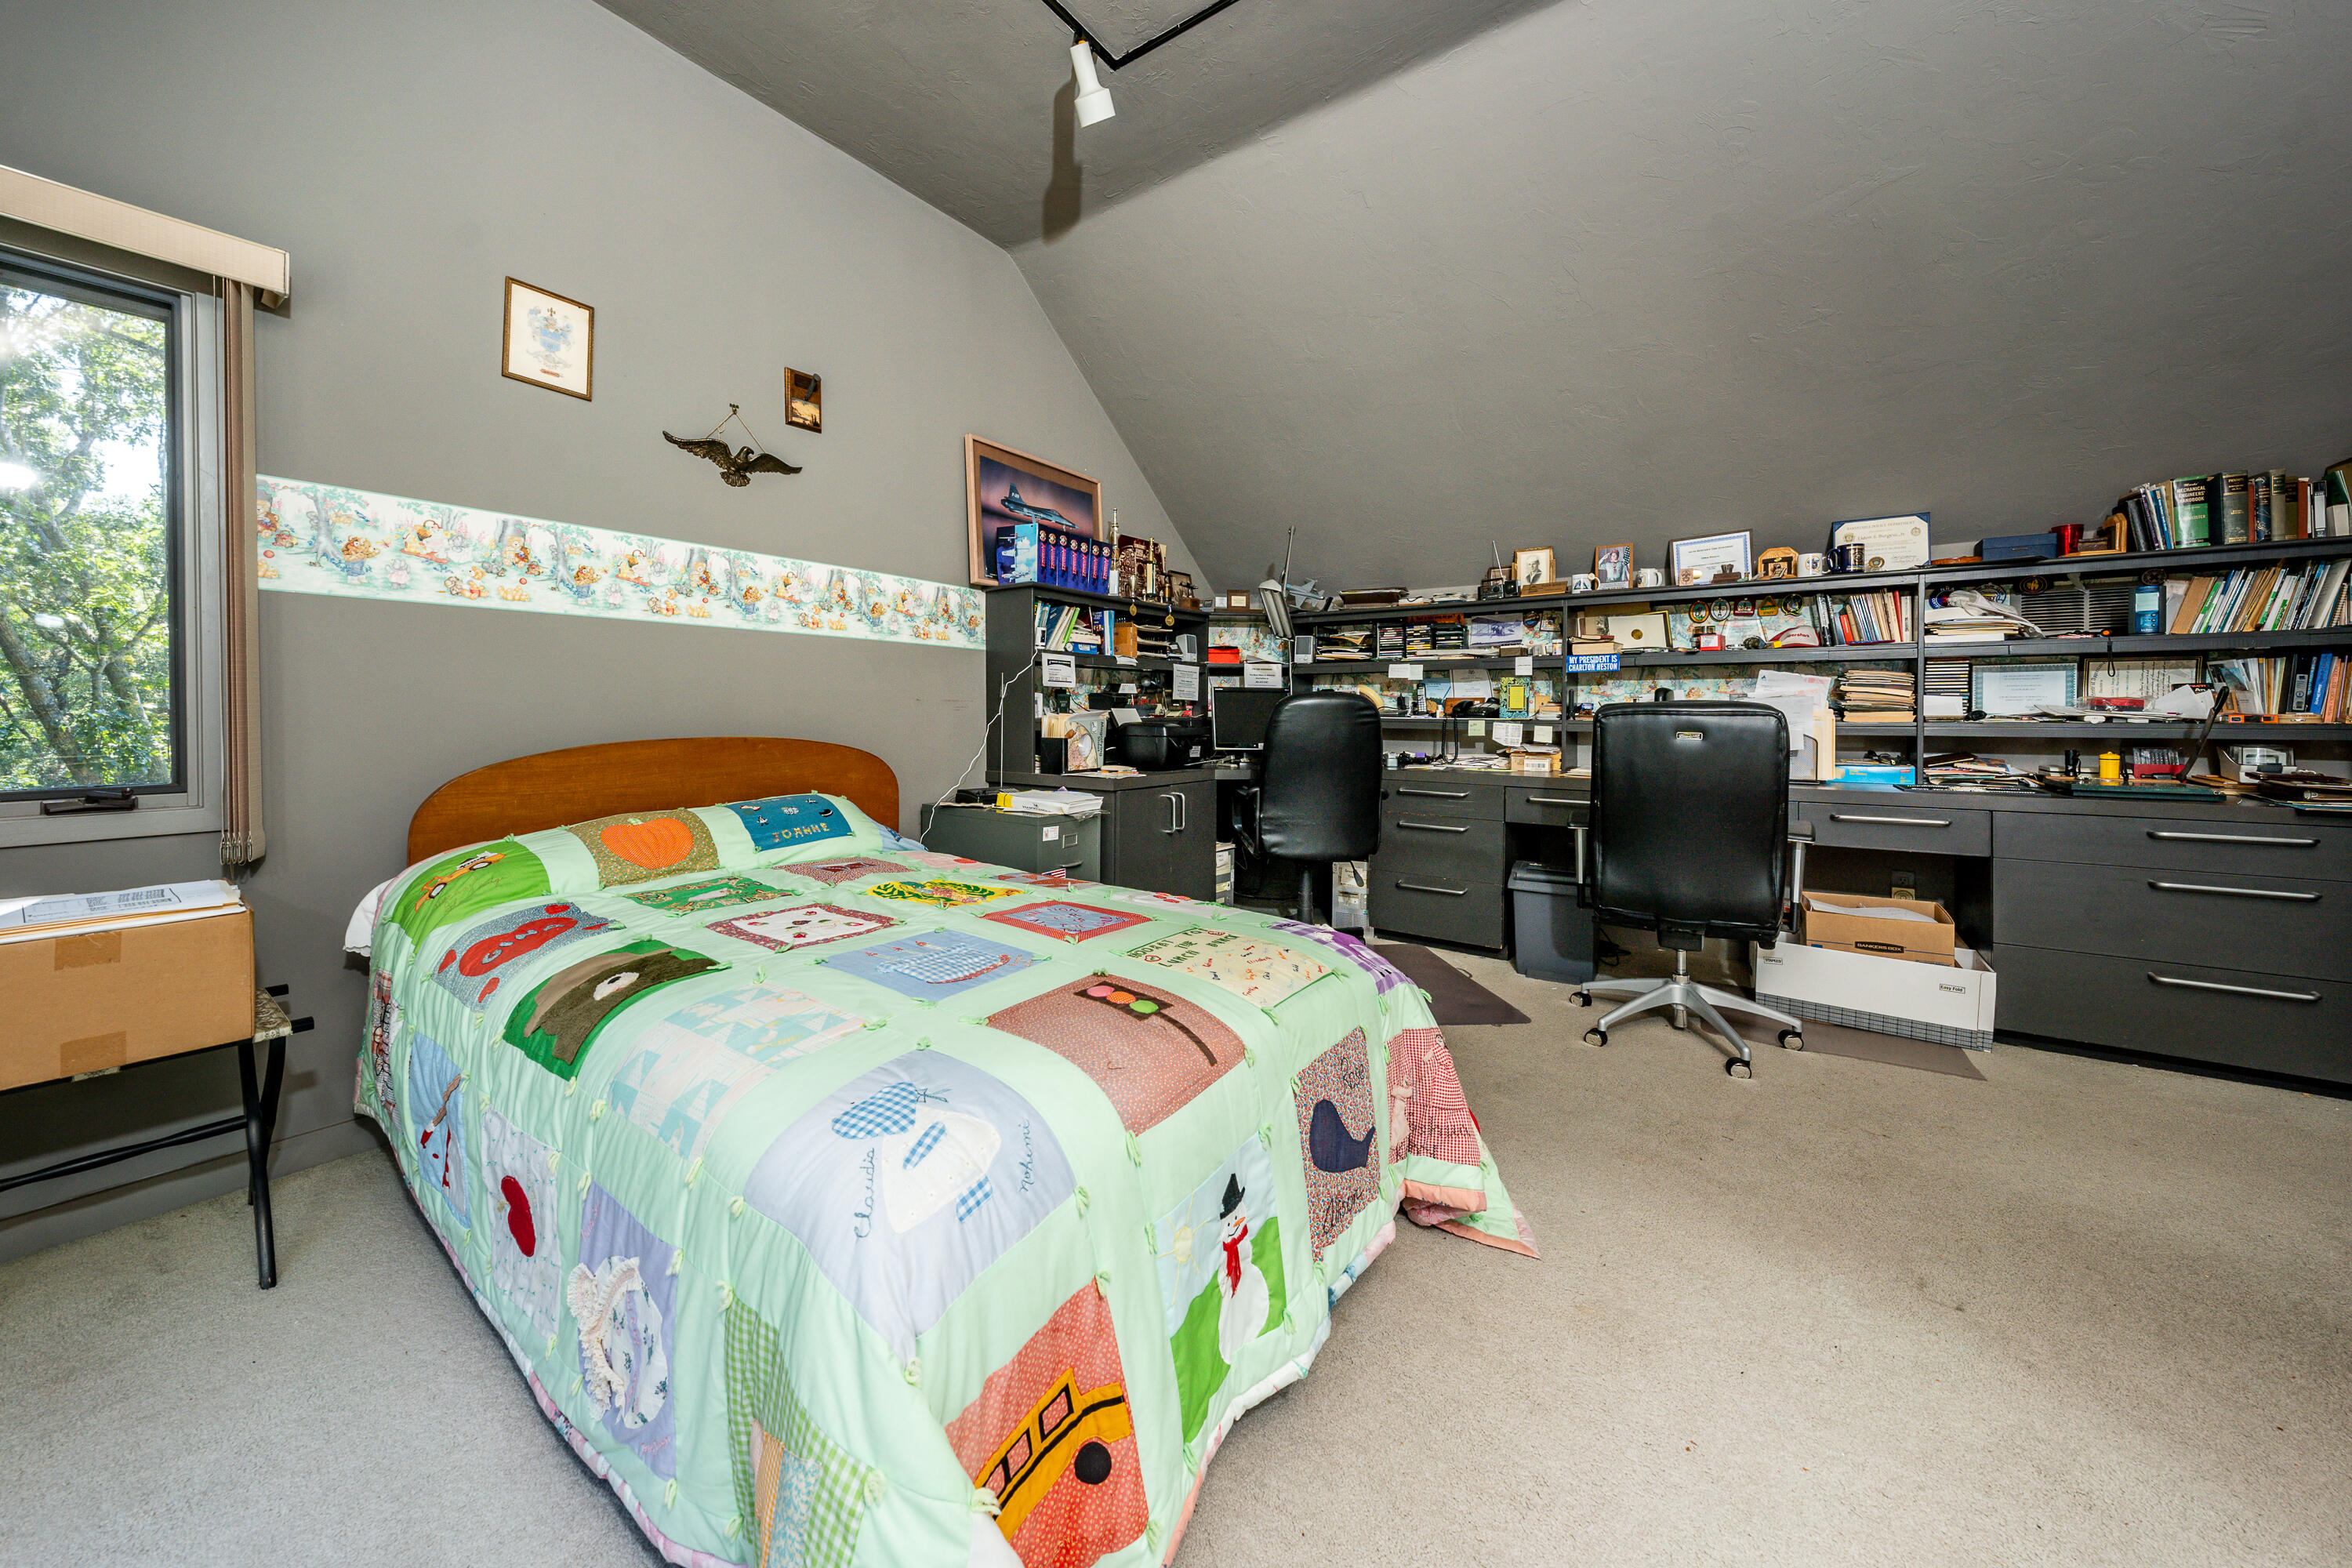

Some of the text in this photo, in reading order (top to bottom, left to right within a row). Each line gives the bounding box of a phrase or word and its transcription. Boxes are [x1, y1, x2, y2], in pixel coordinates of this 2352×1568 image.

[1579, 655, 1610, 663] PRESIDENT
[1569, 662, 1618, 672] CHARLTON HESTON
[771, 822, 831, 843] JOANNE
[1857, 942, 1887, 950] BANKERS
